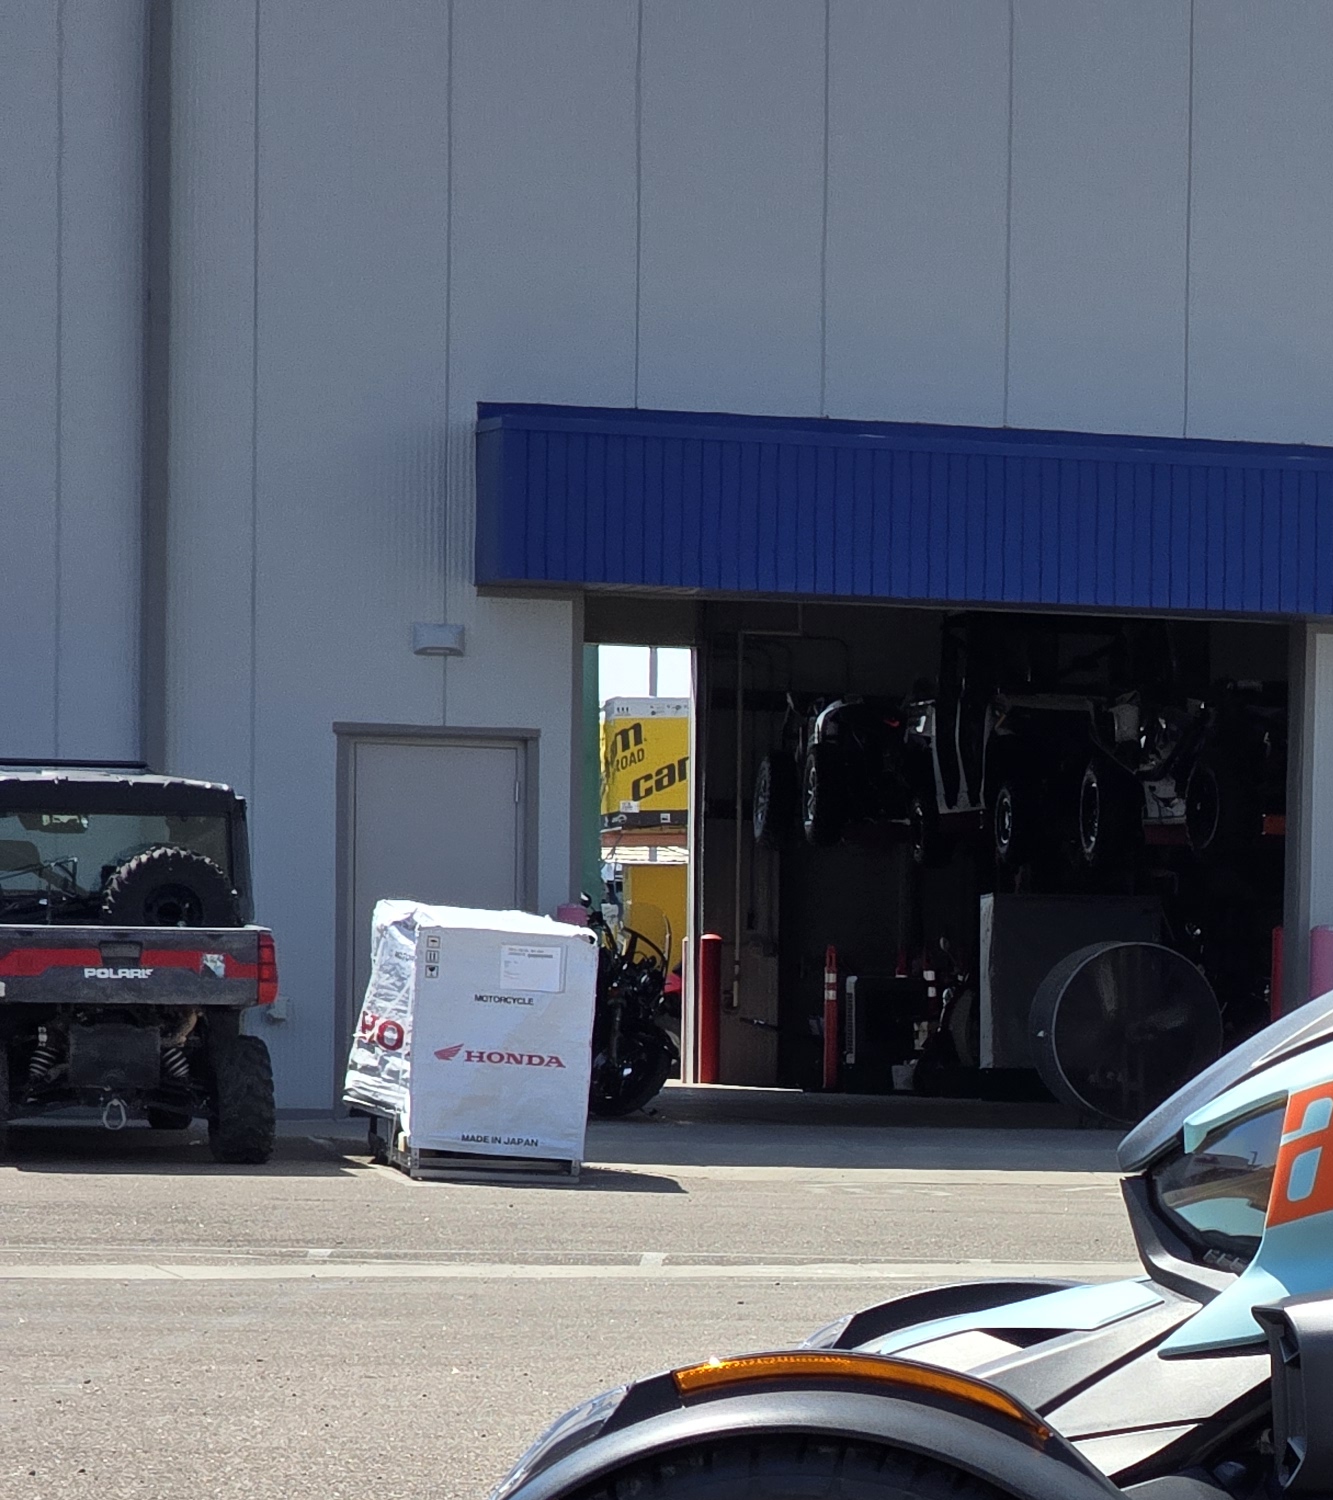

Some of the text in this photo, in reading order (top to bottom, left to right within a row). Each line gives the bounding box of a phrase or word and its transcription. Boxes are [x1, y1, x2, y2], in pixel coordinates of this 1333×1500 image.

[474, 994, 534, 1006] MOTORCYCLE
[464, 1050, 567, 1069] HONDA
[461, 1134, 540, 1147] MADE IN JAPAN
